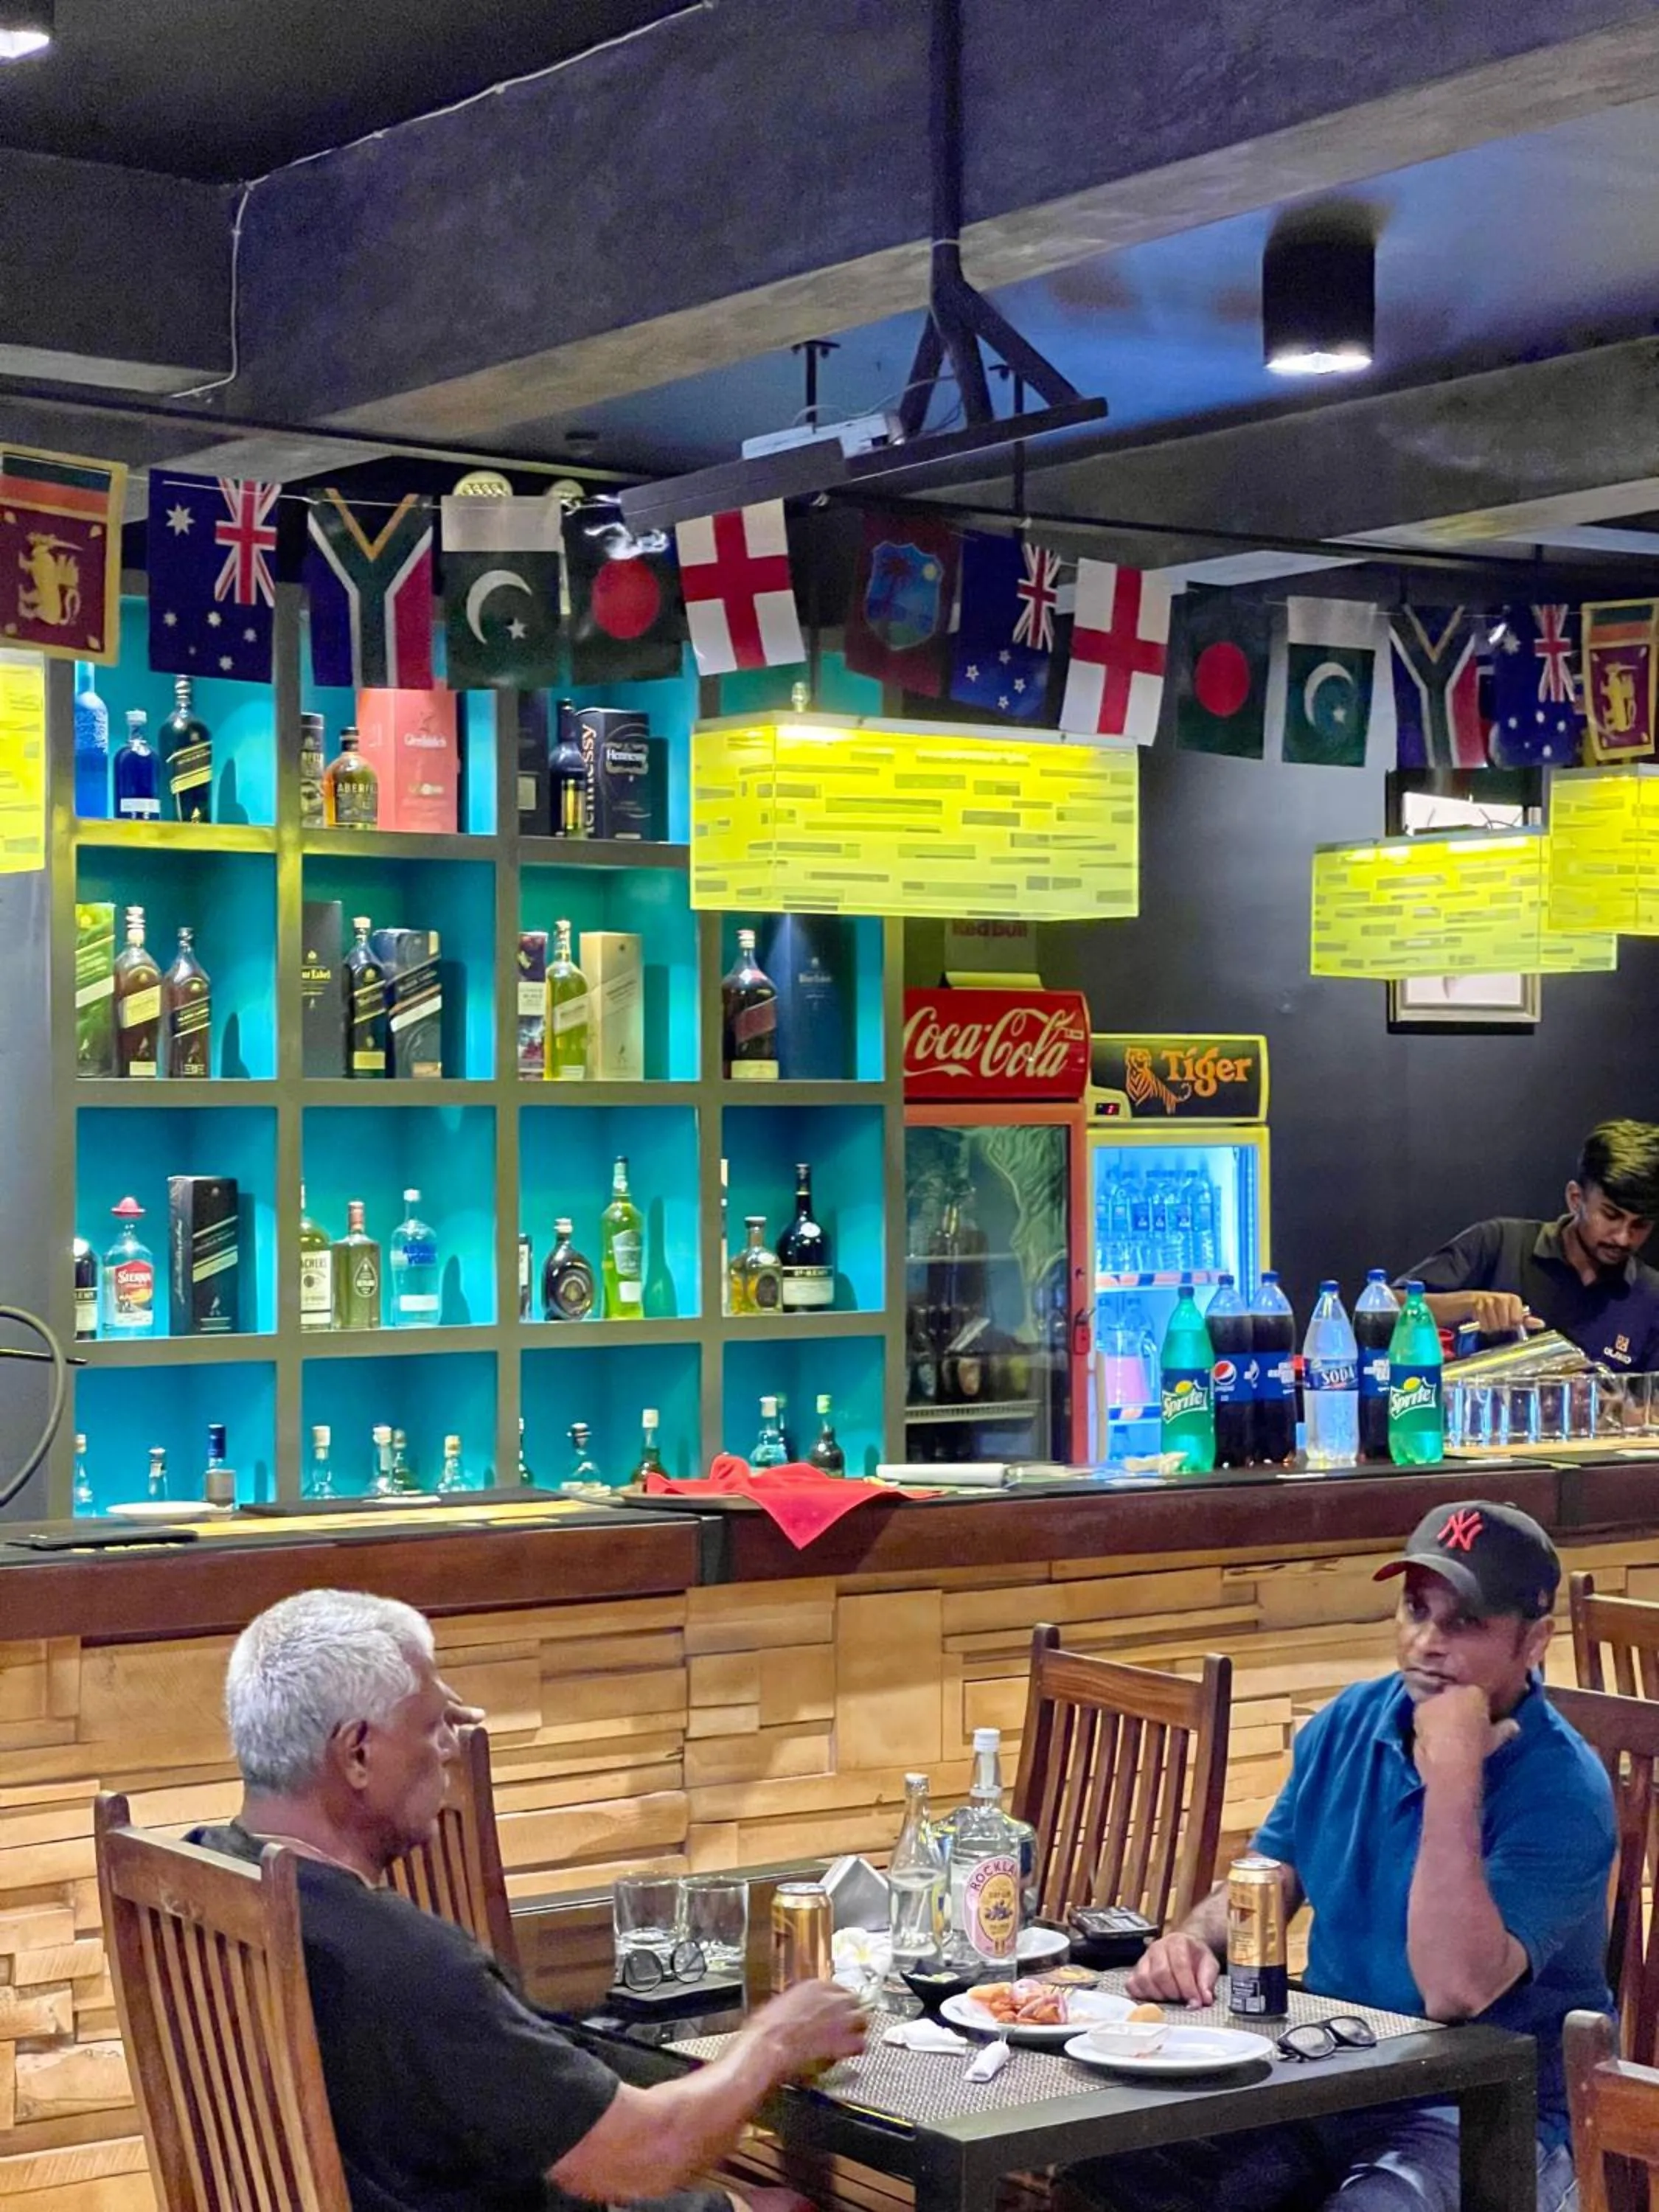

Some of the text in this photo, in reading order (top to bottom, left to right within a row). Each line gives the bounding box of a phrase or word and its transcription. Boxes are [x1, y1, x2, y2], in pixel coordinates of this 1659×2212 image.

[903, 1006, 1076, 1078] Coca-Cola
[1161, 1046, 1252, 1098] Tiger
[1321, 1366, 1355, 1383] SODA
[1163, 1390, 1203, 1419] Sprite
[1387, 1388, 1432, 1415] Sprite
